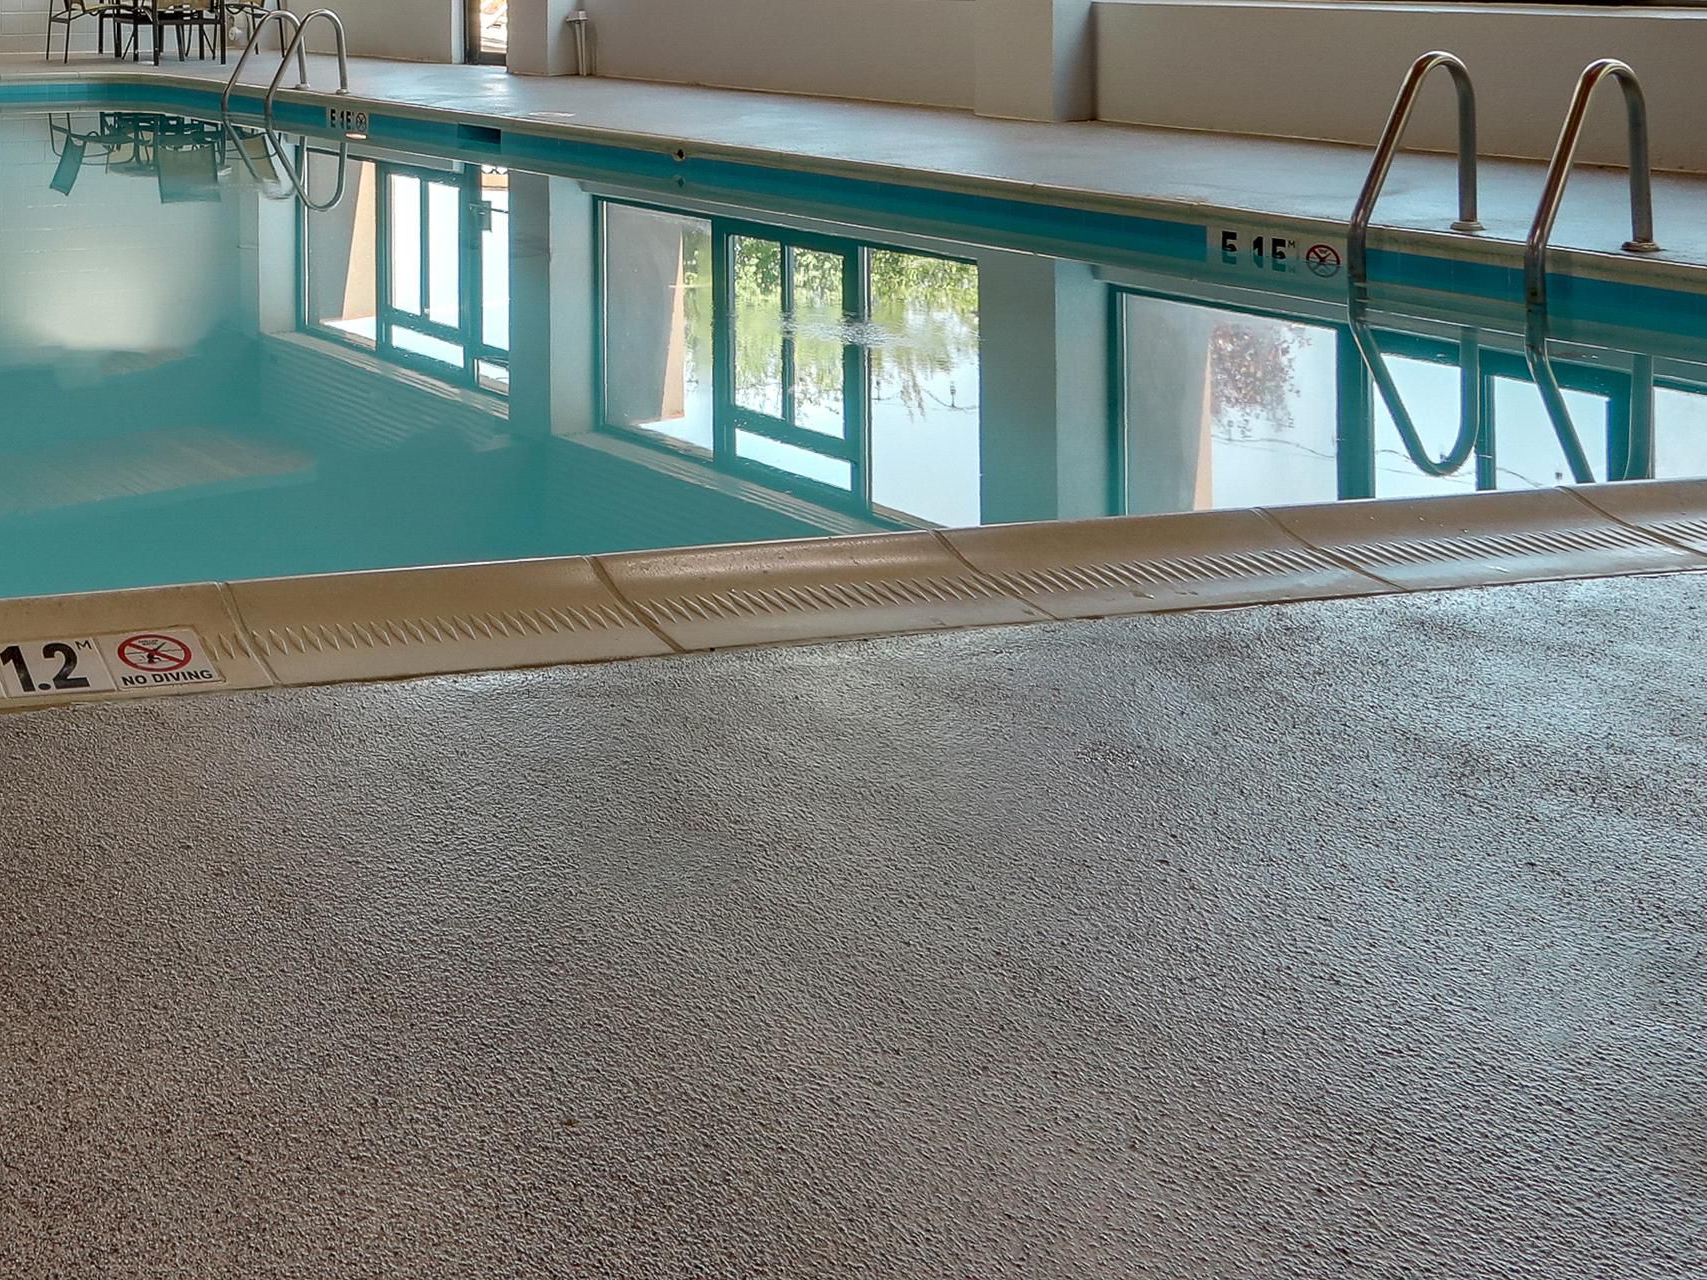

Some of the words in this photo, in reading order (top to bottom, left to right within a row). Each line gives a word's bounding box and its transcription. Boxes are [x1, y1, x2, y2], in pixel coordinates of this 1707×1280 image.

[0, 642, 91, 692] 1.2
[120, 674, 148, 687] NO
[151, 669, 214, 684] DIVING
